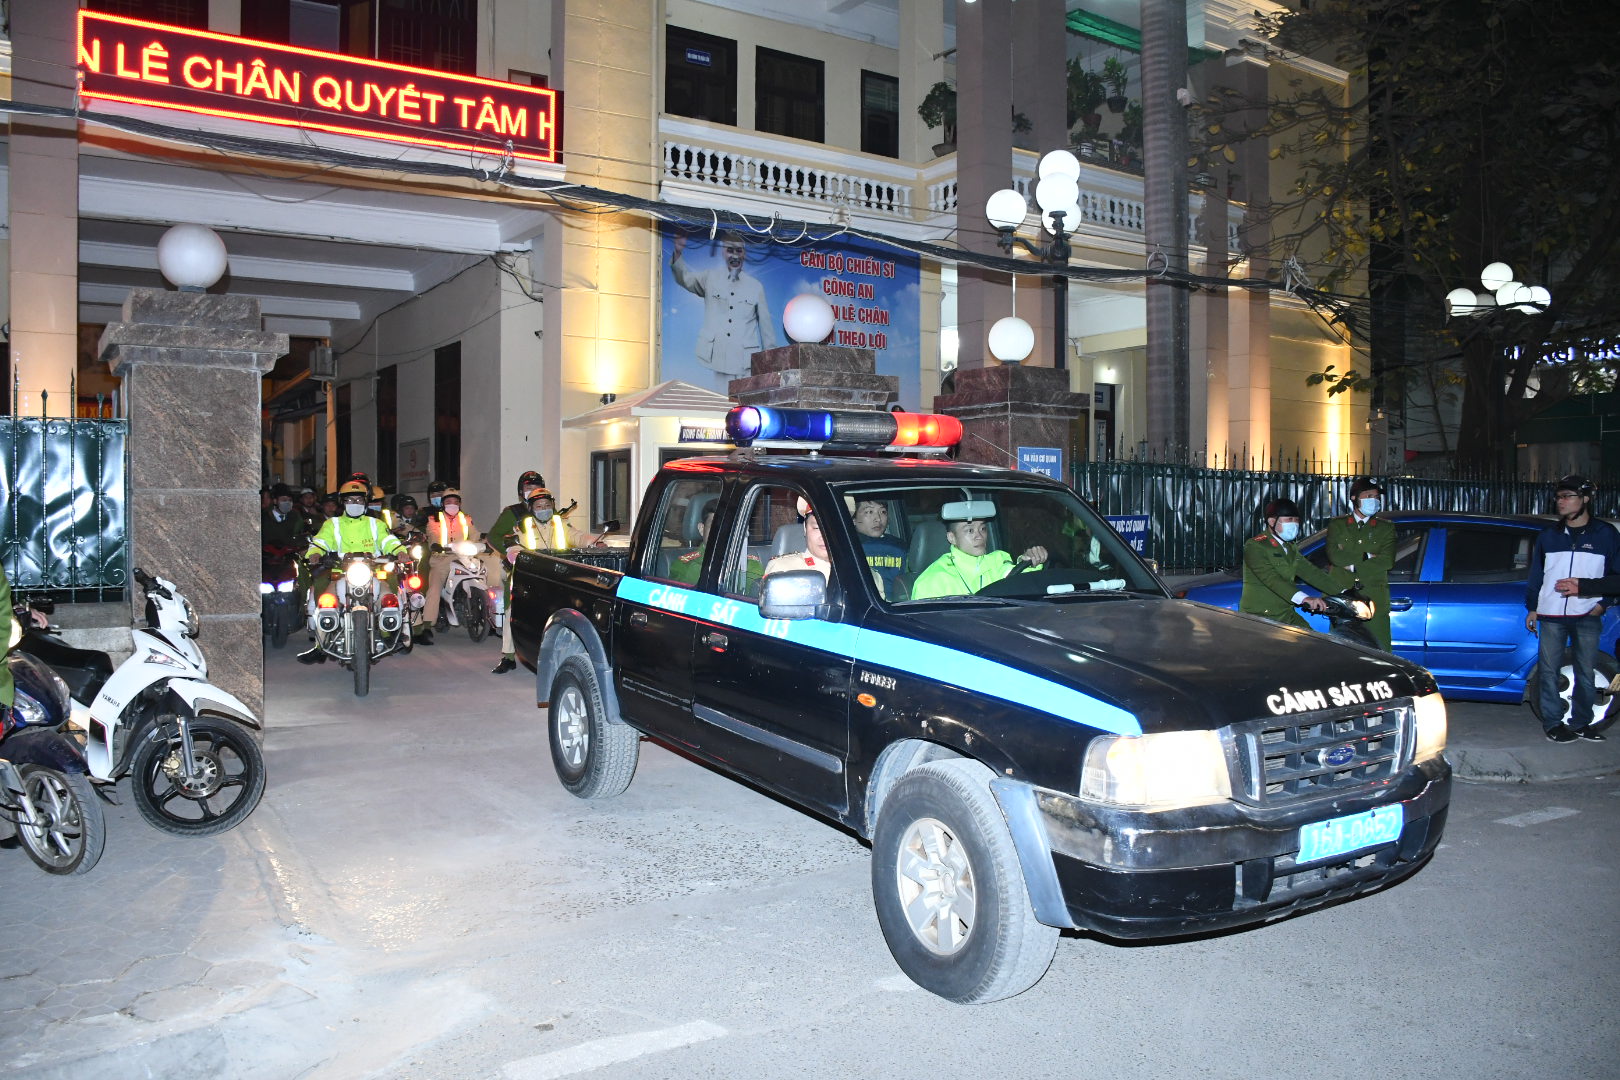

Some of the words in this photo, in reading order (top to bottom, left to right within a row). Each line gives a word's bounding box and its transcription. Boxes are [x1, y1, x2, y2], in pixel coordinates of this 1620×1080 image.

[117, 41, 169, 84] LÊ
[183, 56, 300, 103] CHÂN
[454, 96, 527, 137] TÂM
[828, 252, 844, 275] BỘ
[846, 256, 881, 277] CHIẾN
[823, 277, 855, 298] CÔNG
[857, 282, 874, 300] AN
[842, 304, 857, 323] LÊ
[858, 306, 889, 325] CHÂN
[838, 330, 867, 348] THEO
[869, 331, 888, 349] LỜI
[709, 600, 739, 625] SÁT
[1266, 687, 1327, 715] CẢNH
[1328, 681, 1365, 707] SÁT
[1366, 680, 1393, 700] 113
